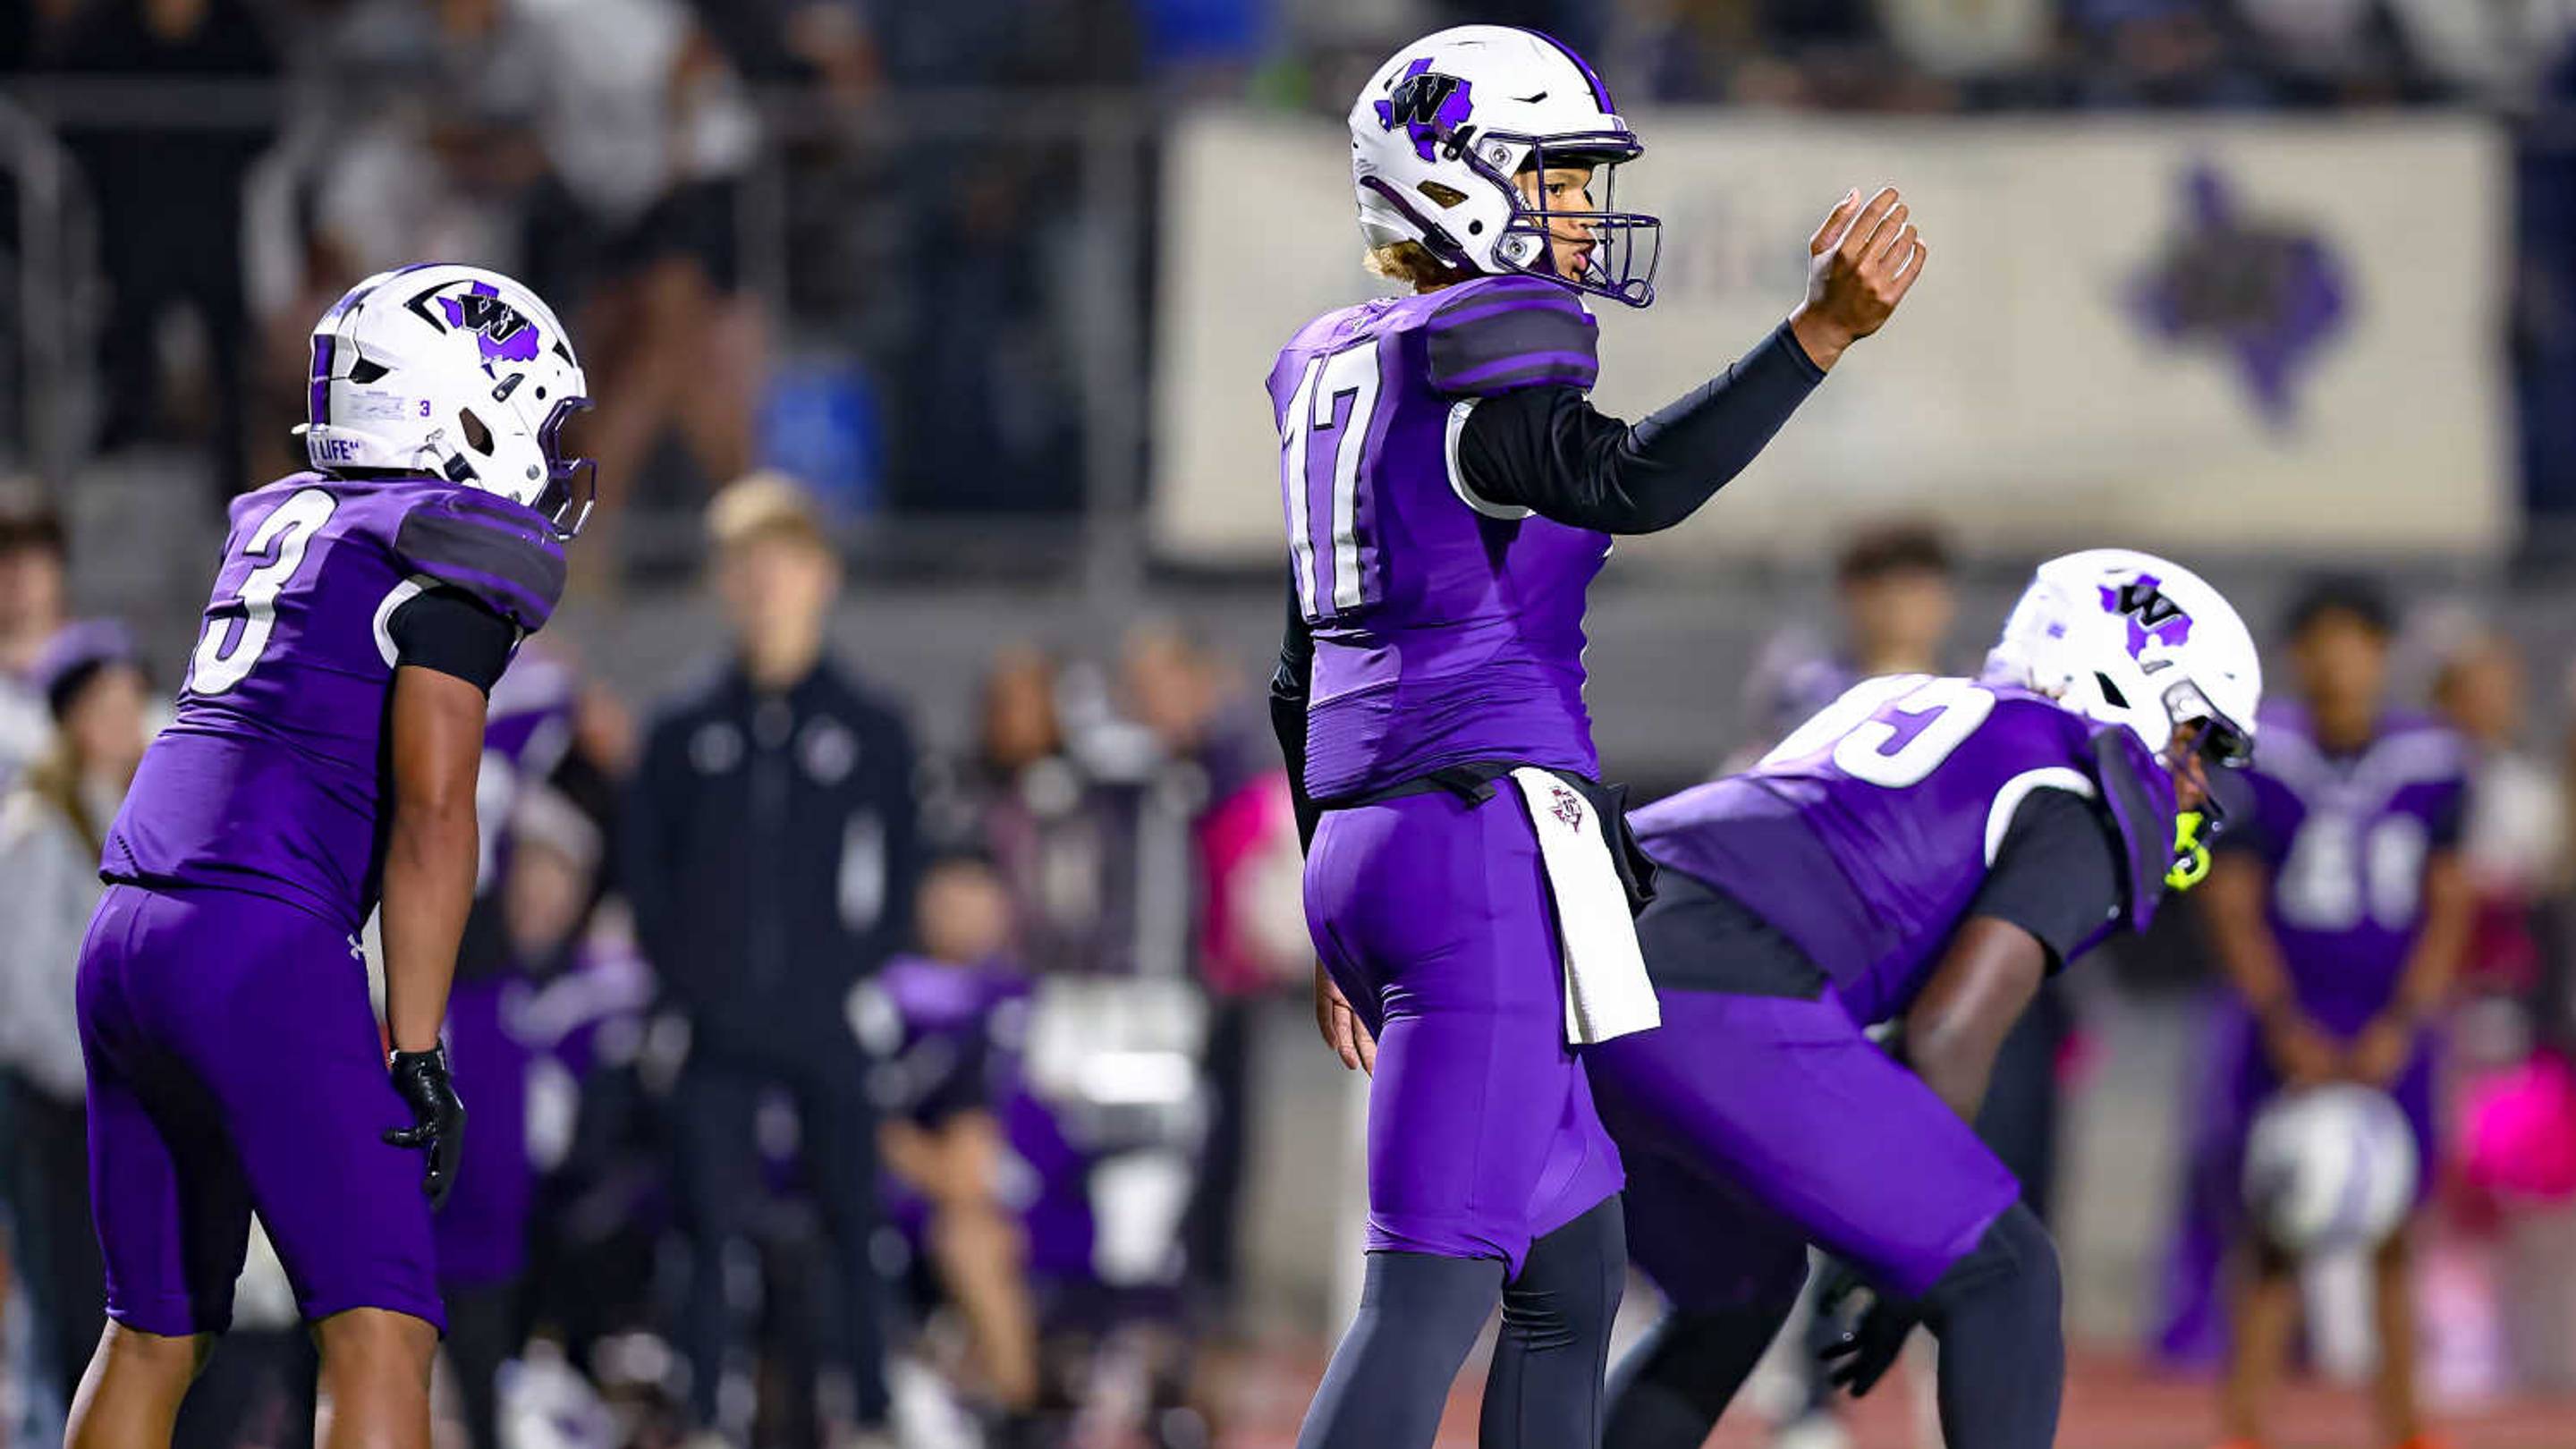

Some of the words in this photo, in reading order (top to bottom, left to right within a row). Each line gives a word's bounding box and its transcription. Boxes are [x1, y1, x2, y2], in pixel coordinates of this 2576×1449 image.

[1390, 72, 1460, 128] W
[458, 292, 531, 346] W
[419, 399, 431, 418] 3
[1281, 340, 1382, 622] 17
[190, 486, 340, 695] 3
[2116, 584, 2188, 631] W
